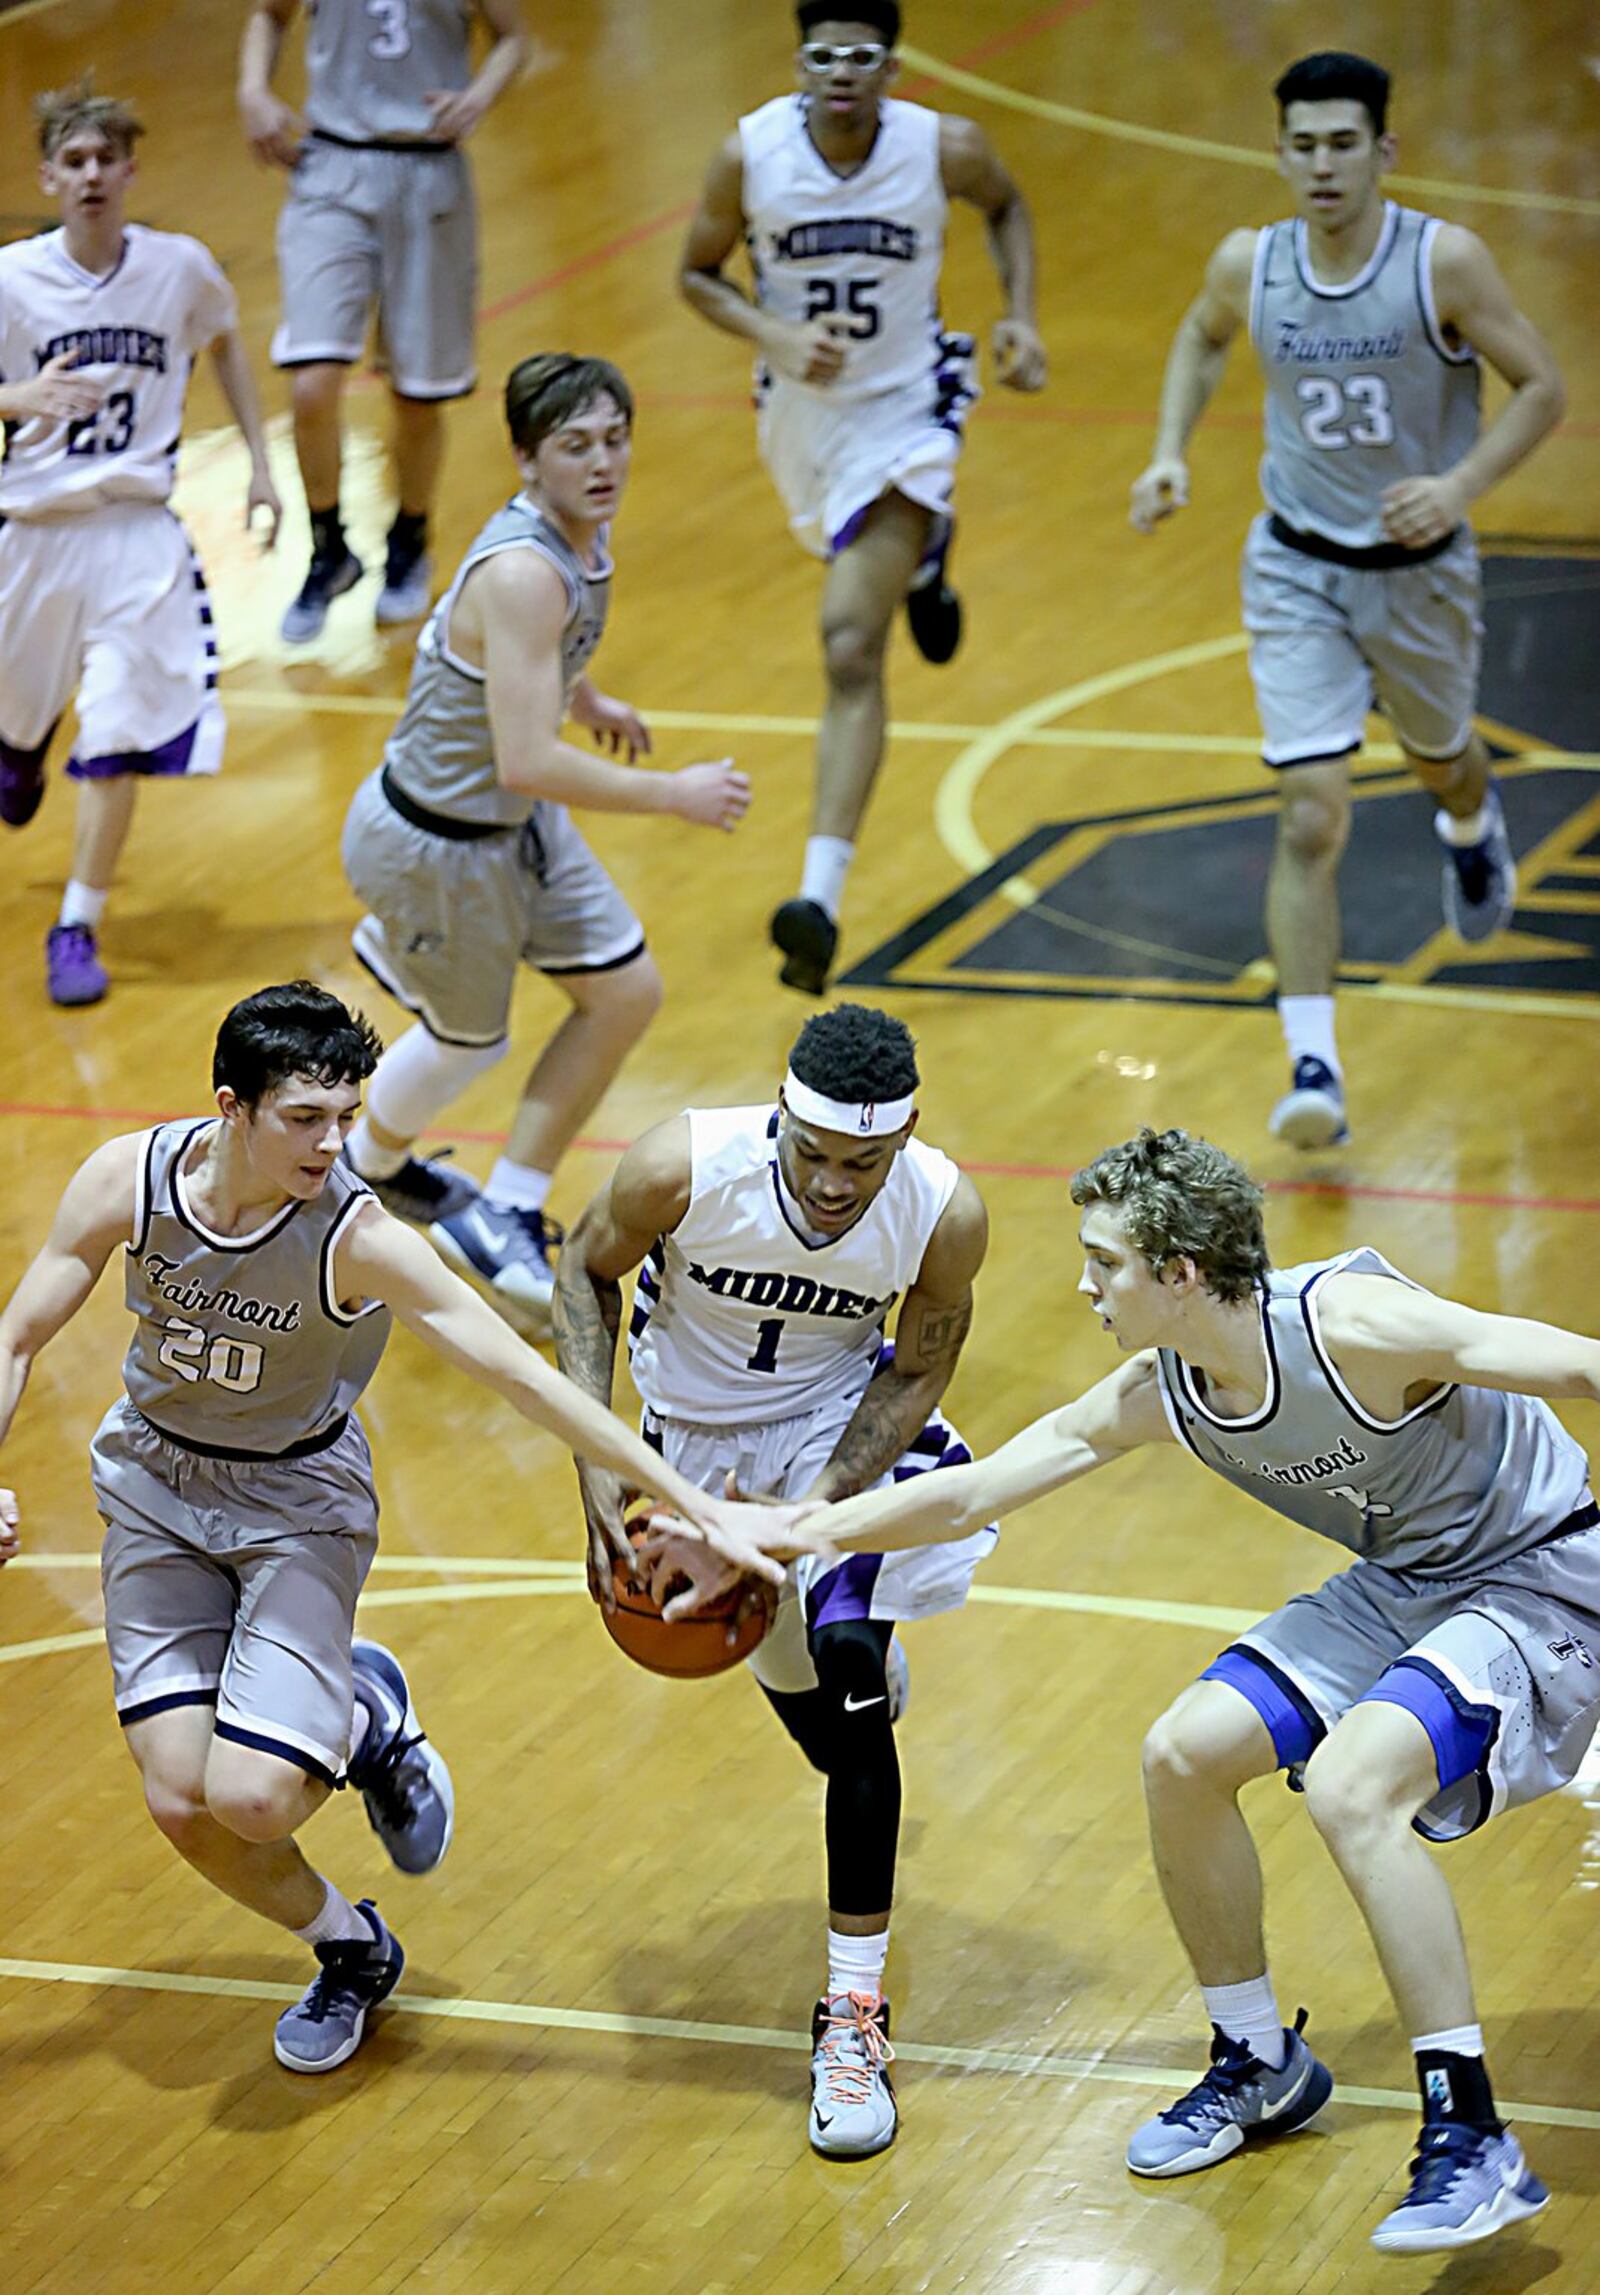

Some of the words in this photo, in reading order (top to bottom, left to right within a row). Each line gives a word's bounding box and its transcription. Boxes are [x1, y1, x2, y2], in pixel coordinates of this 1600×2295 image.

[807, 279, 879, 339] 25
[1296, 373, 1396, 450] 23
[144, 1253, 301, 1333] Fairmont
[158, 1315, 266, 1394] 20
[746, 1318, 786, 1373] 1
